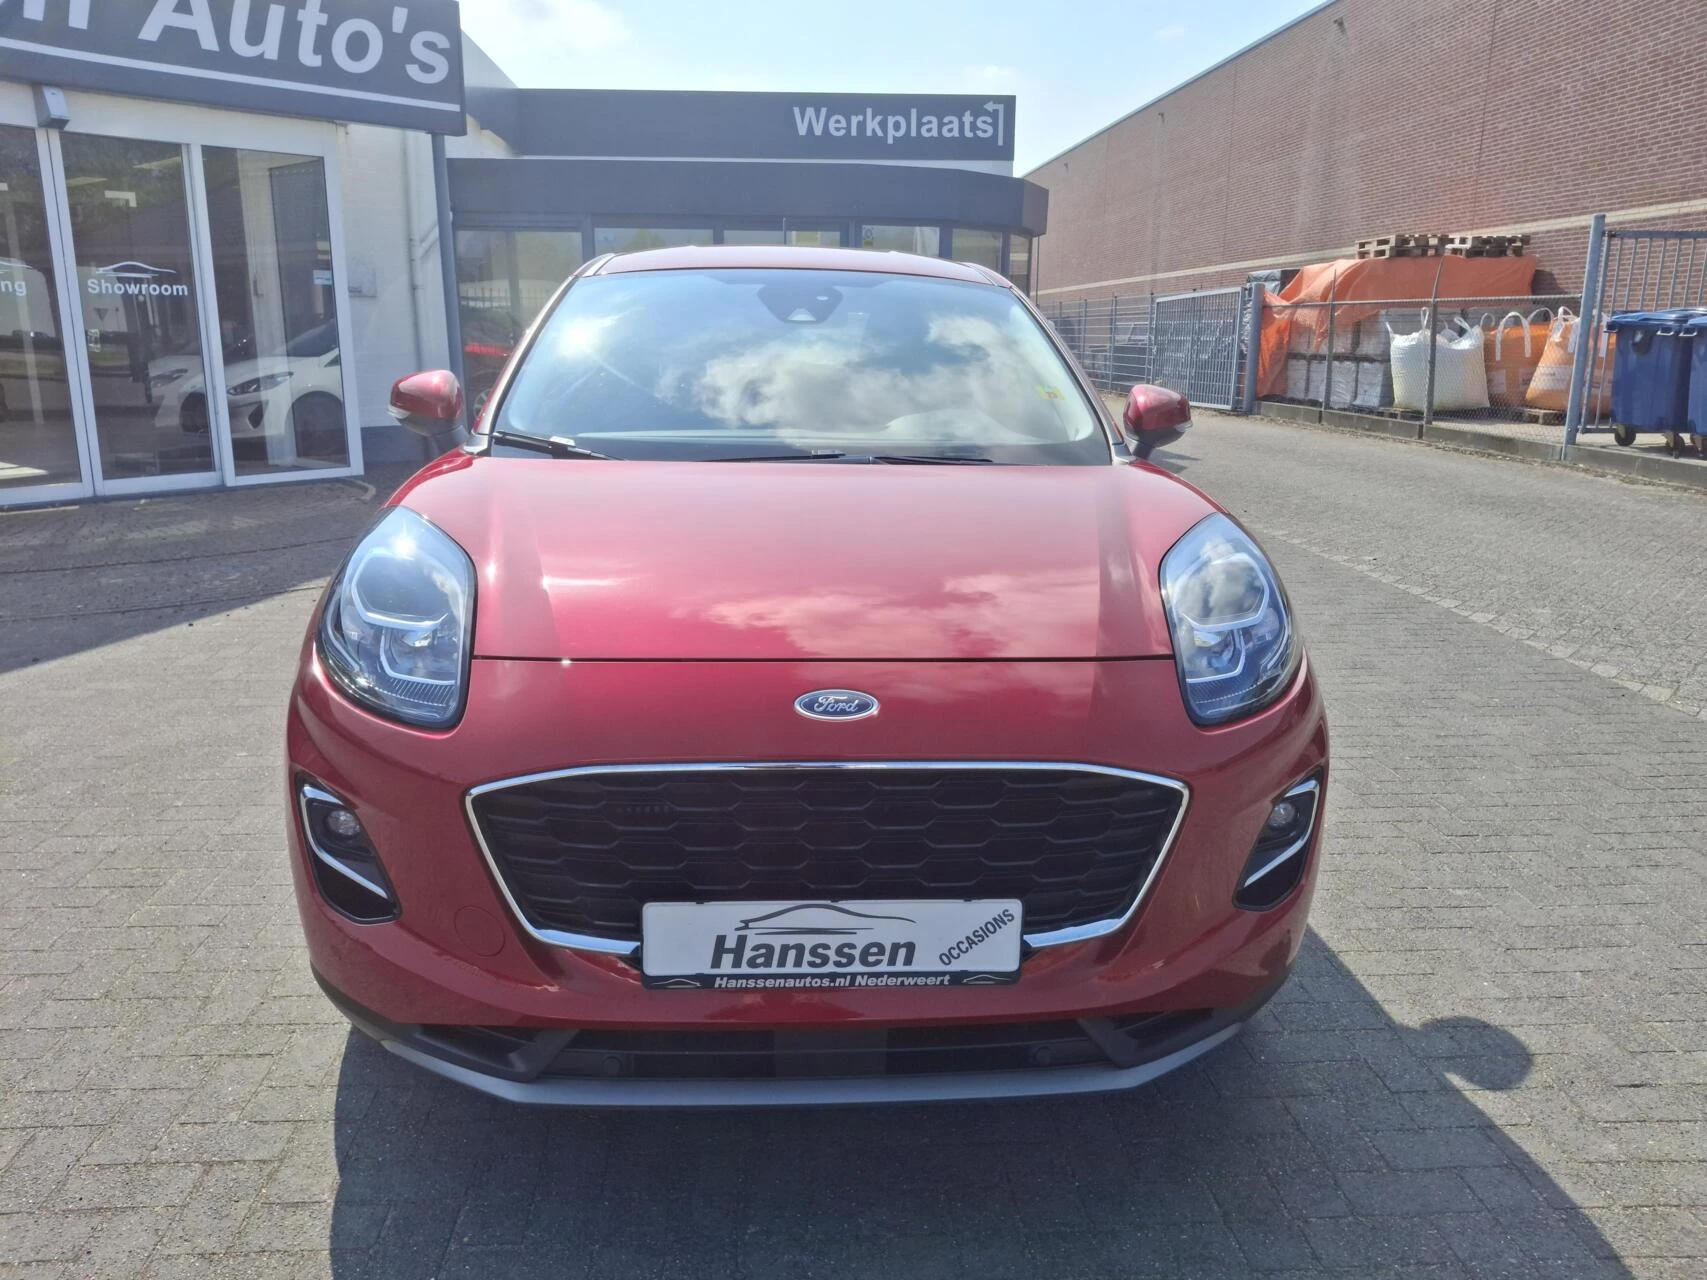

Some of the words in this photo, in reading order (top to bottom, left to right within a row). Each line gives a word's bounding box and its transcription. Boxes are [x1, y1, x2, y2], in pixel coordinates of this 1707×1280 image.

[138, 0, 450, 84] Auto's
[793, 106, 993, 144] Werkplaats
[87, 278, 188, 296] Showroom
[813, 695, 859, 711] Ford
[710, 934, 916, 969] Hanssen
[939, 909, 1015, 966] OCCASIONS
[714, 975, 851, 988] Hanssenautos.nl
[855, 974, 950, 987] Nederweert
